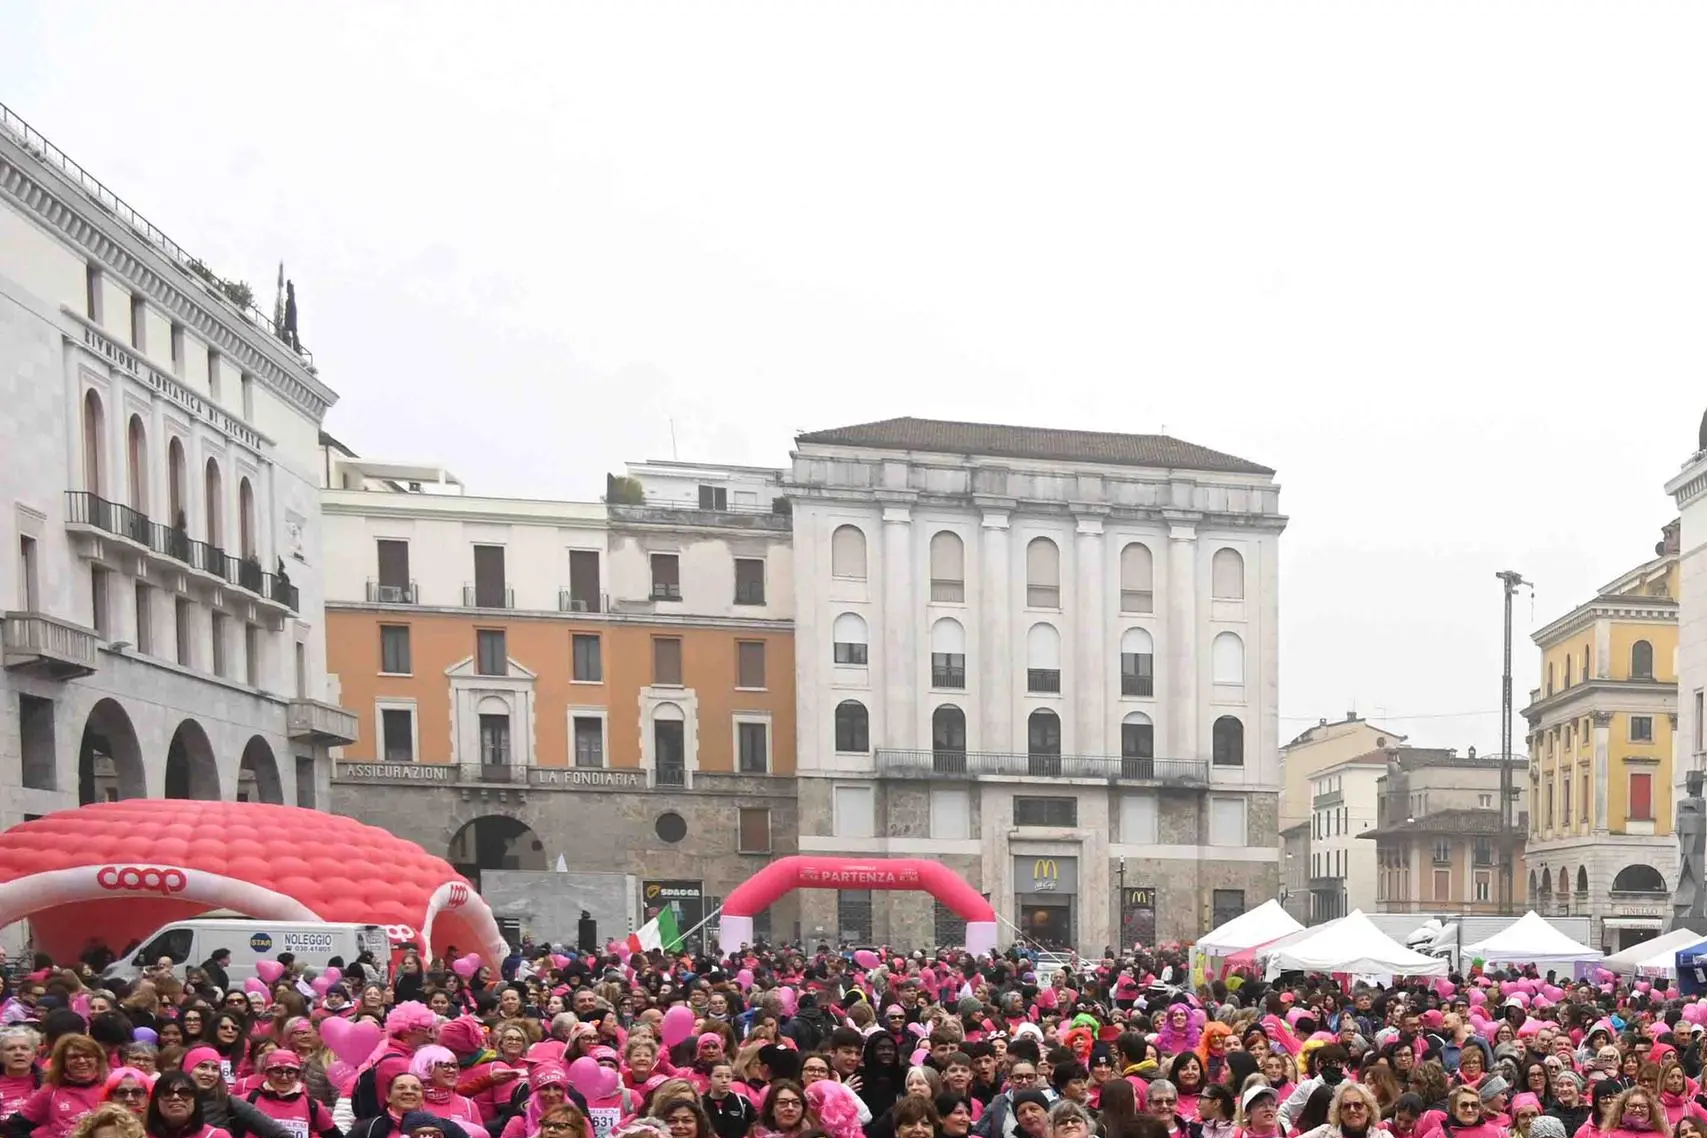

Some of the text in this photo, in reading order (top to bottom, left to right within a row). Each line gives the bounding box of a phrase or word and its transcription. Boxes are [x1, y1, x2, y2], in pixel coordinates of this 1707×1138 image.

[346, 765, 638, 785] ASSICURAZIONI LA FONDIARIA
[97, 866, 188, 895] coop
[821, 871, 895, 882] PARTENZA
[250, 938, 272, 946] STAR
[285, 934, 332, 945] NOLEGGIO
[593, 1116, 614, 1127] 631
